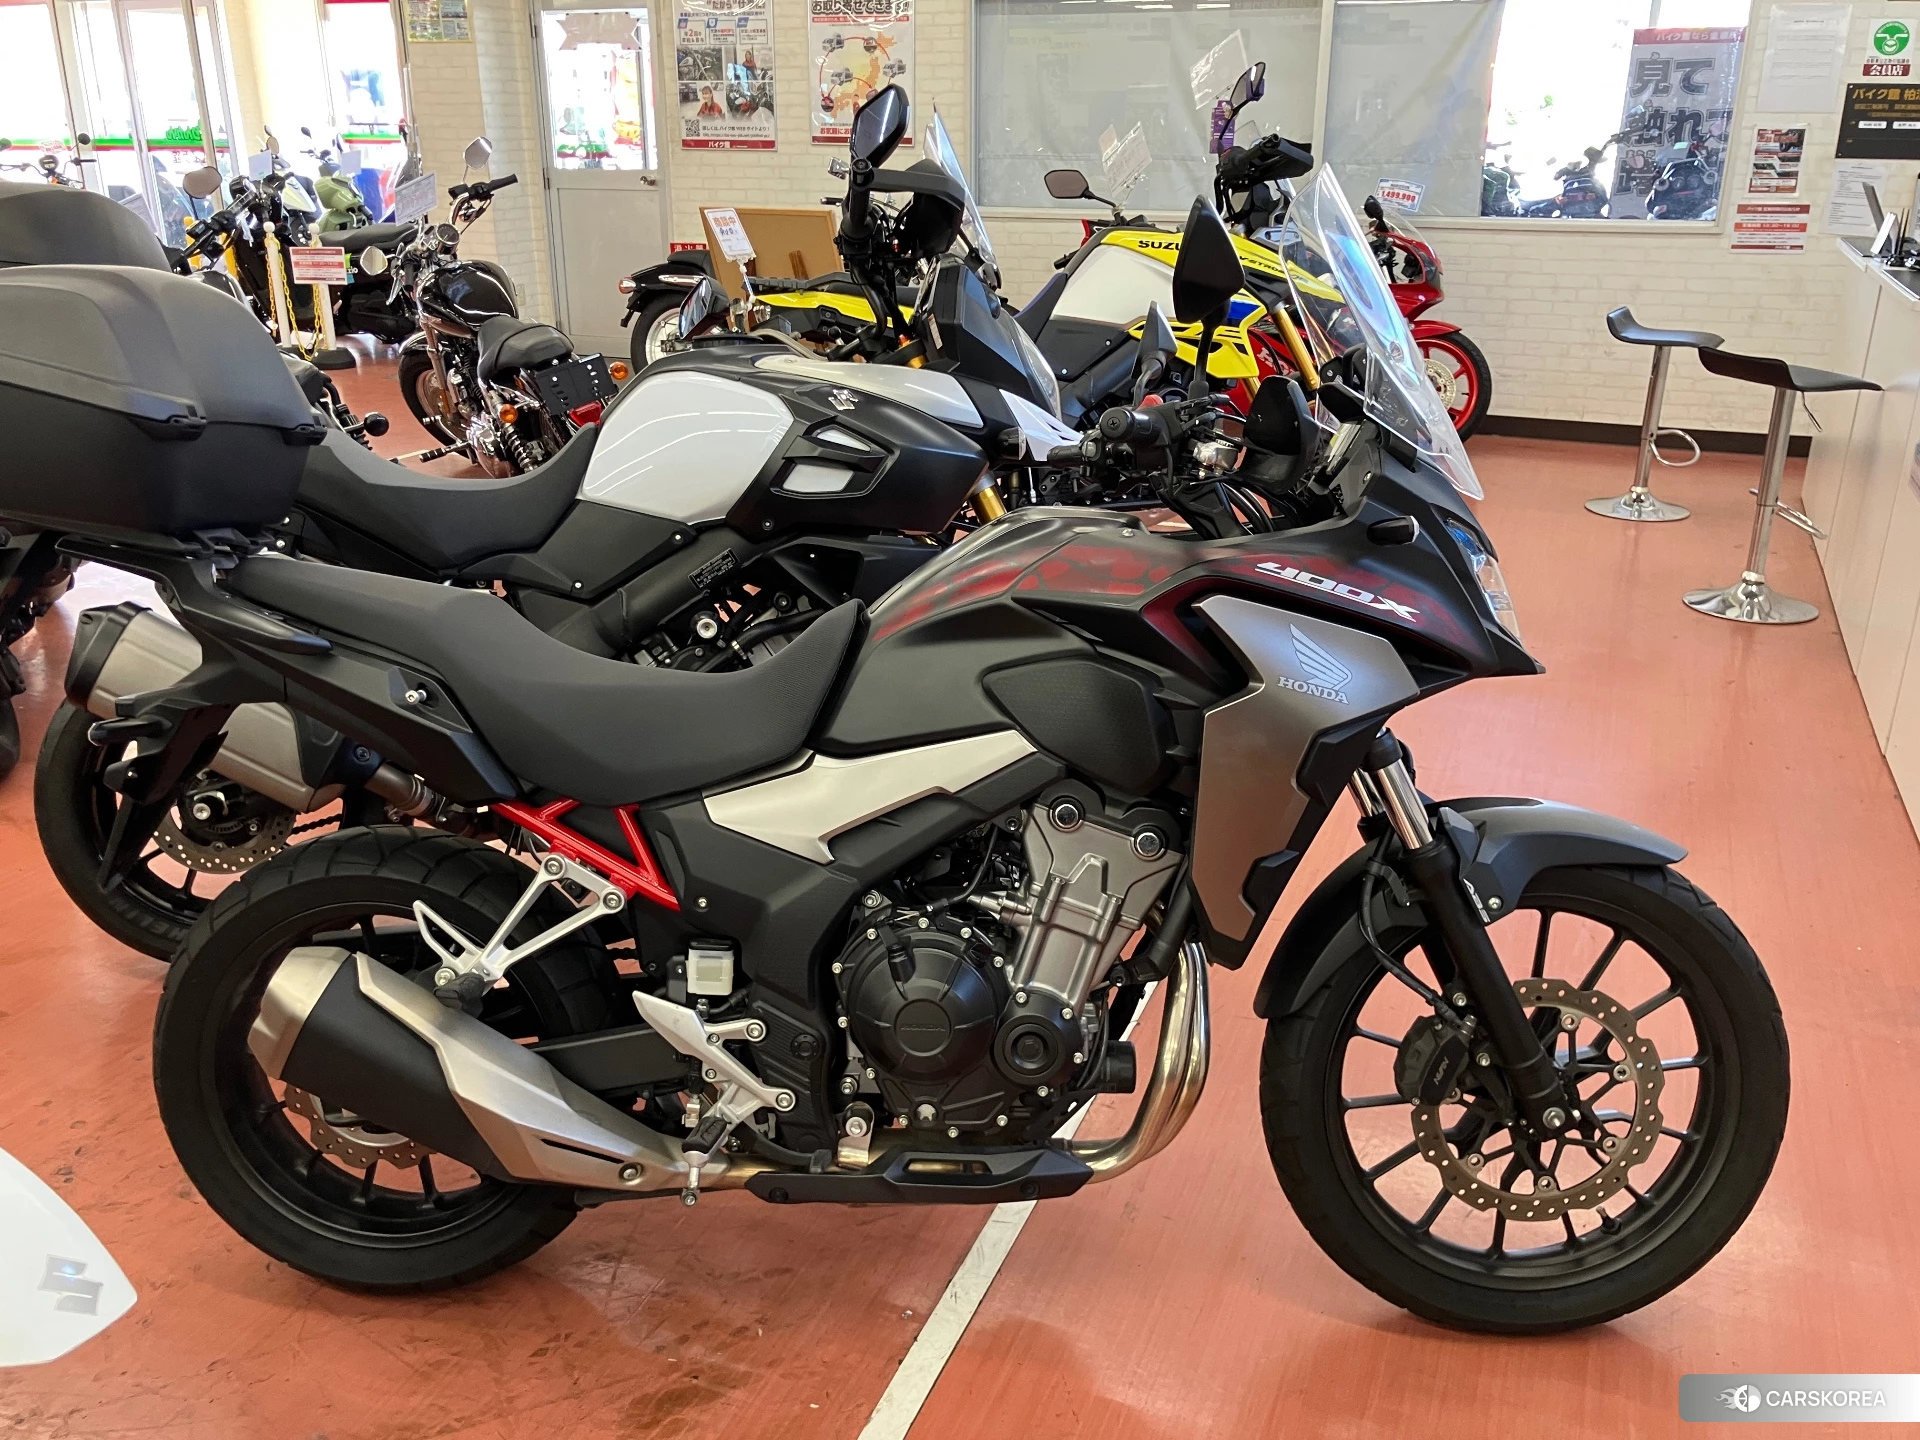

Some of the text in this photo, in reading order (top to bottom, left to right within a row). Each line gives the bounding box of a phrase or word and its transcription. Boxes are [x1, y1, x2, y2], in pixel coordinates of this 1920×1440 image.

[1631, 58, 1716, 97] 見て
[1254, 562, 1420, 622] 400X
[1277, 676, 1349, 705] HONDA
